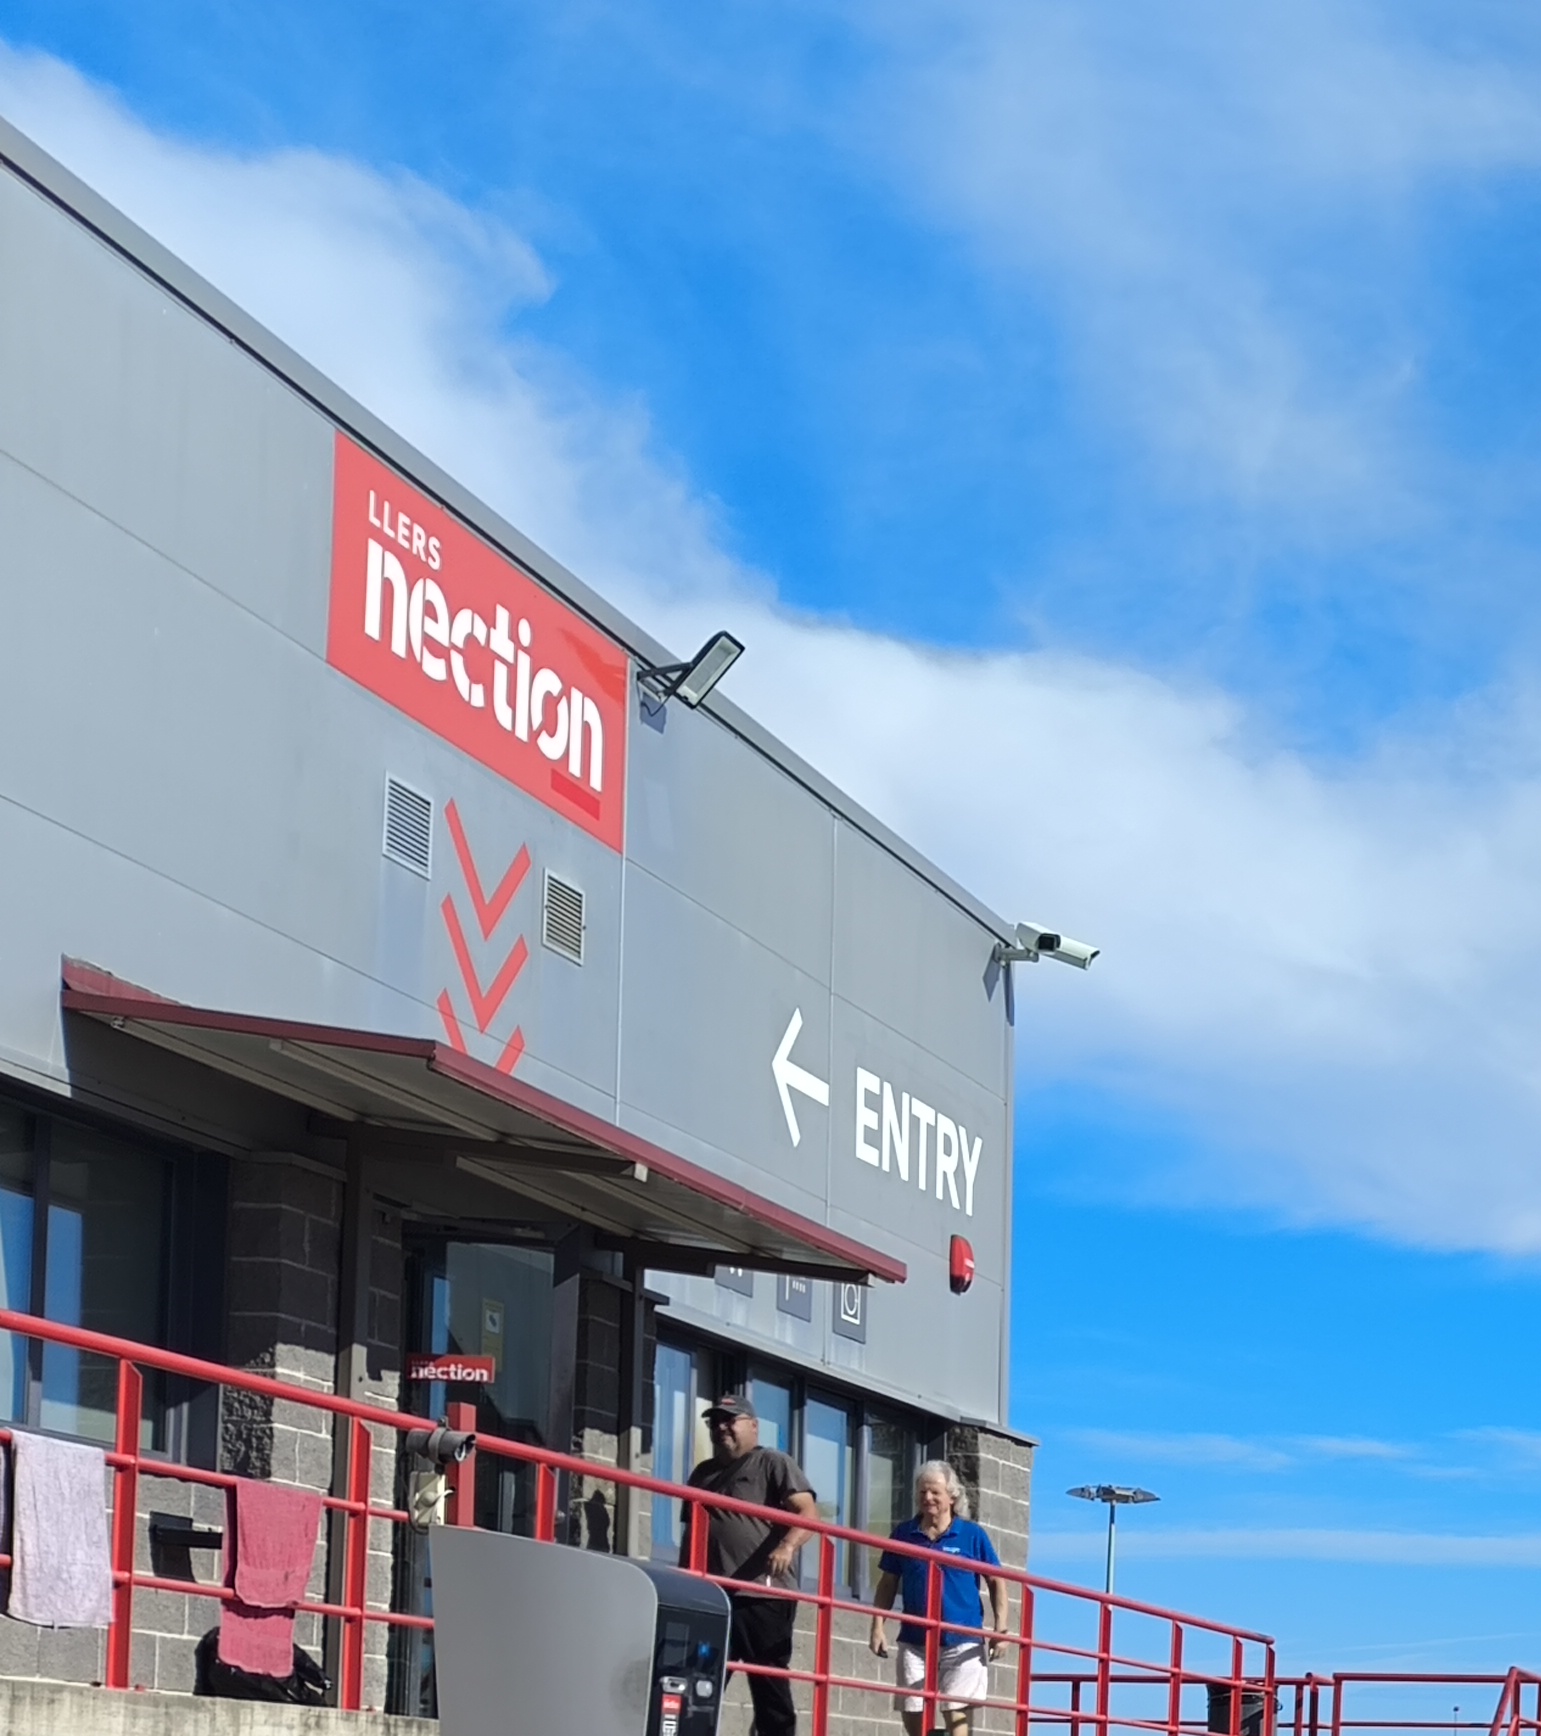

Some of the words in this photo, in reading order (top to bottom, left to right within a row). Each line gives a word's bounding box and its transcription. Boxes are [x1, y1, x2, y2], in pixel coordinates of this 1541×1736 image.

[368, 489, 442, 571] LLERS
[364, 537, 603, 793] nection
[855, 1066, 984, 1217] ENTRY
[410, 1362, 490, 1382] nection
